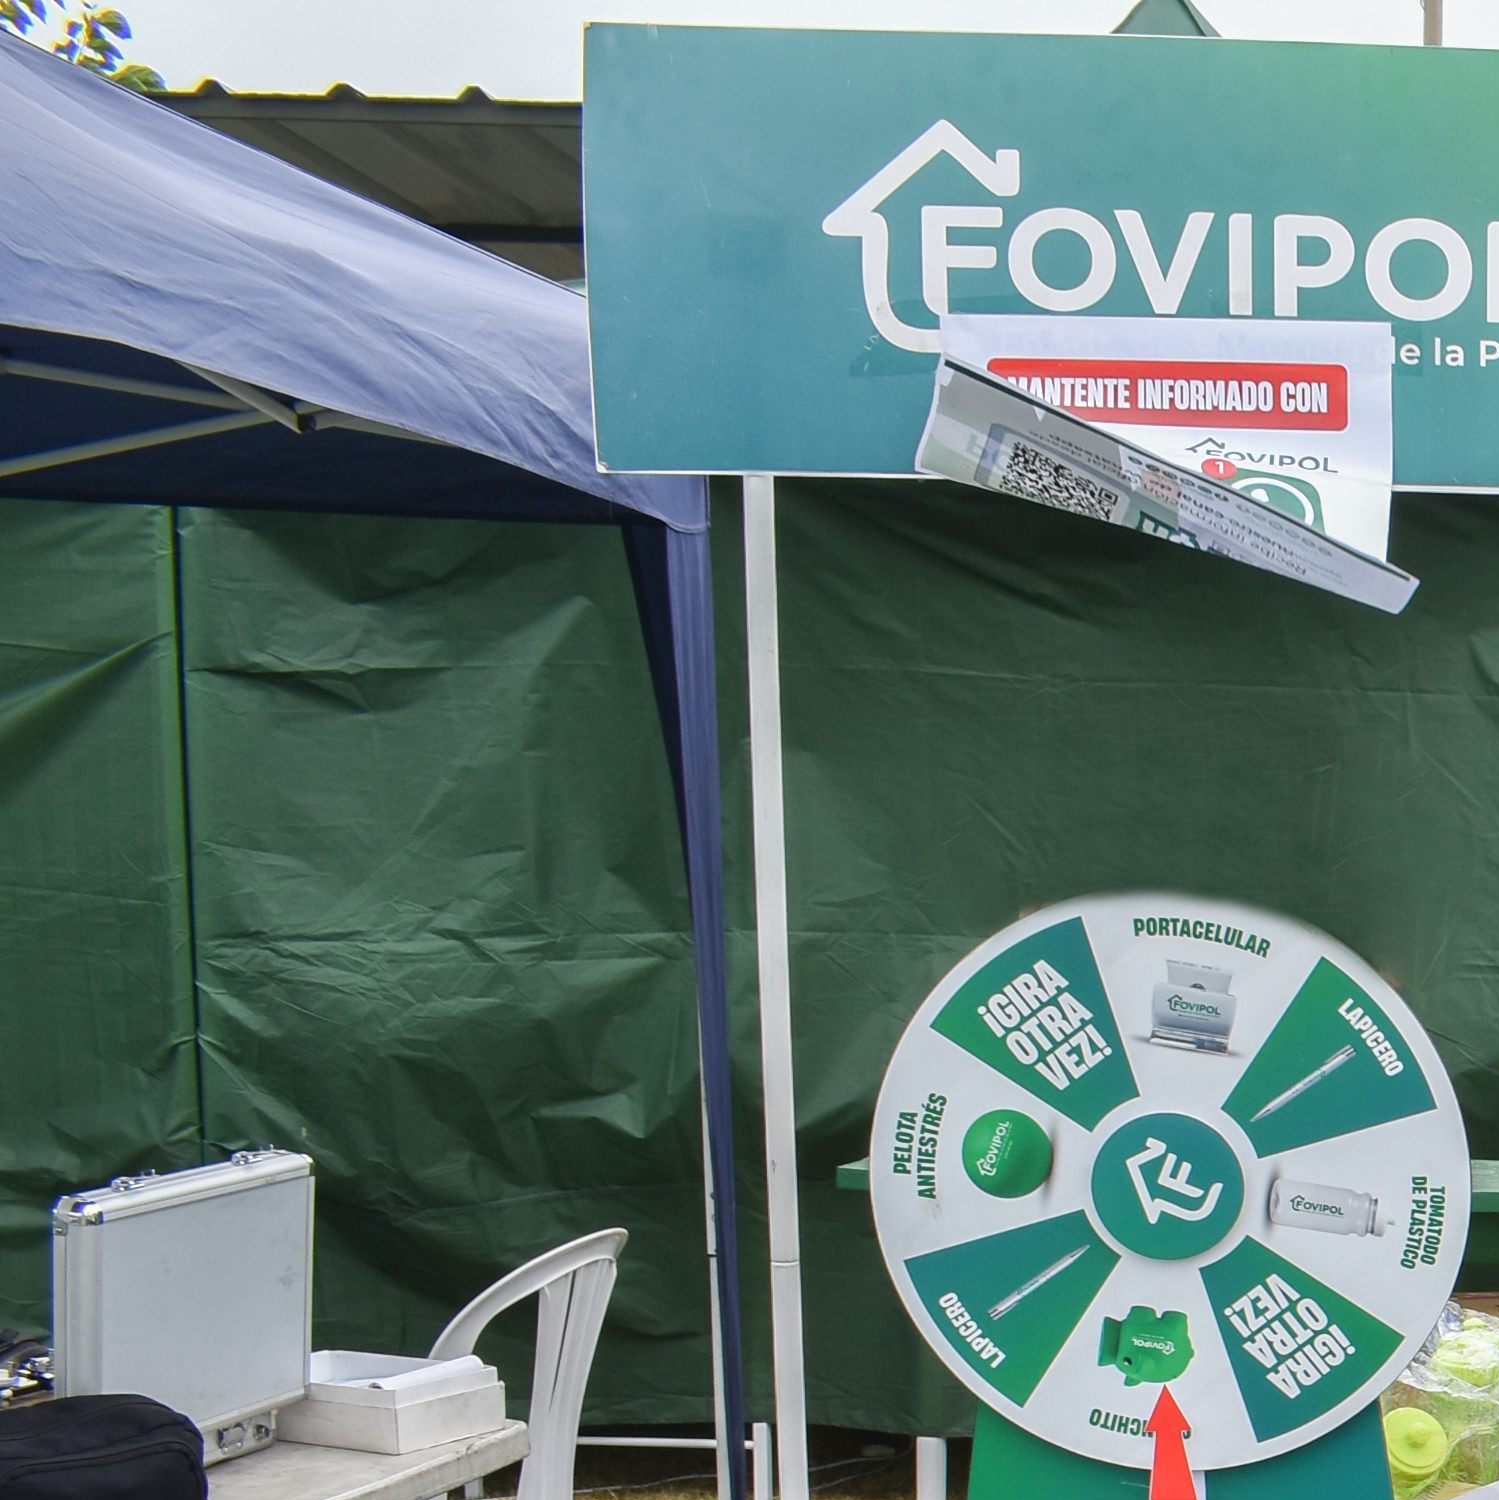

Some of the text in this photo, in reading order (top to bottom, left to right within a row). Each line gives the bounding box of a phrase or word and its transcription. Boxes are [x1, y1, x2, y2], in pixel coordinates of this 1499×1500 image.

[1391, 336, 1421, 365] e
[1434, 337, 1465, 367] la
[1137, 379, 1274, 412] INFORMADO
[1280, 381, 1328, 413] CON
[1215, 461, 1225, 474] 1
[1132, 917, 1272, 959] PORTACELULAR
[977, 959, 1070, 1039] ¡GIRA
[1006, 991, 1094, 1066] OTRA
[1174, 1000, 1221, 1015] FOVIPOL
[1034, 1023, 1113, 1091] VEZ!
[1337, 998, 1404, 1078] LAPICERO
[892, 1110, 919, 1175] PELOTA
[917, 1092, 948, 1200] ANTIESTRÉS
[982, 1120, 1010, 1172] FOVIPOL
[1296, 1200, 1344, 1217] FOVIPOL
[1400, 1176, 1428, 1270] DE PLASTICO
[1420, 1186, 1446, 1266] TOMATODO
[938, 1291, 1007, 1369] LAPICERO
[1223, 1273, 1302, 1338] VEZ!
[1242, 1298, 1329, 1370] OTRA
[1264, 1324, 1356, 1400] ¡GIRA
[1089, 1408, 1192, 1440] CHITO
